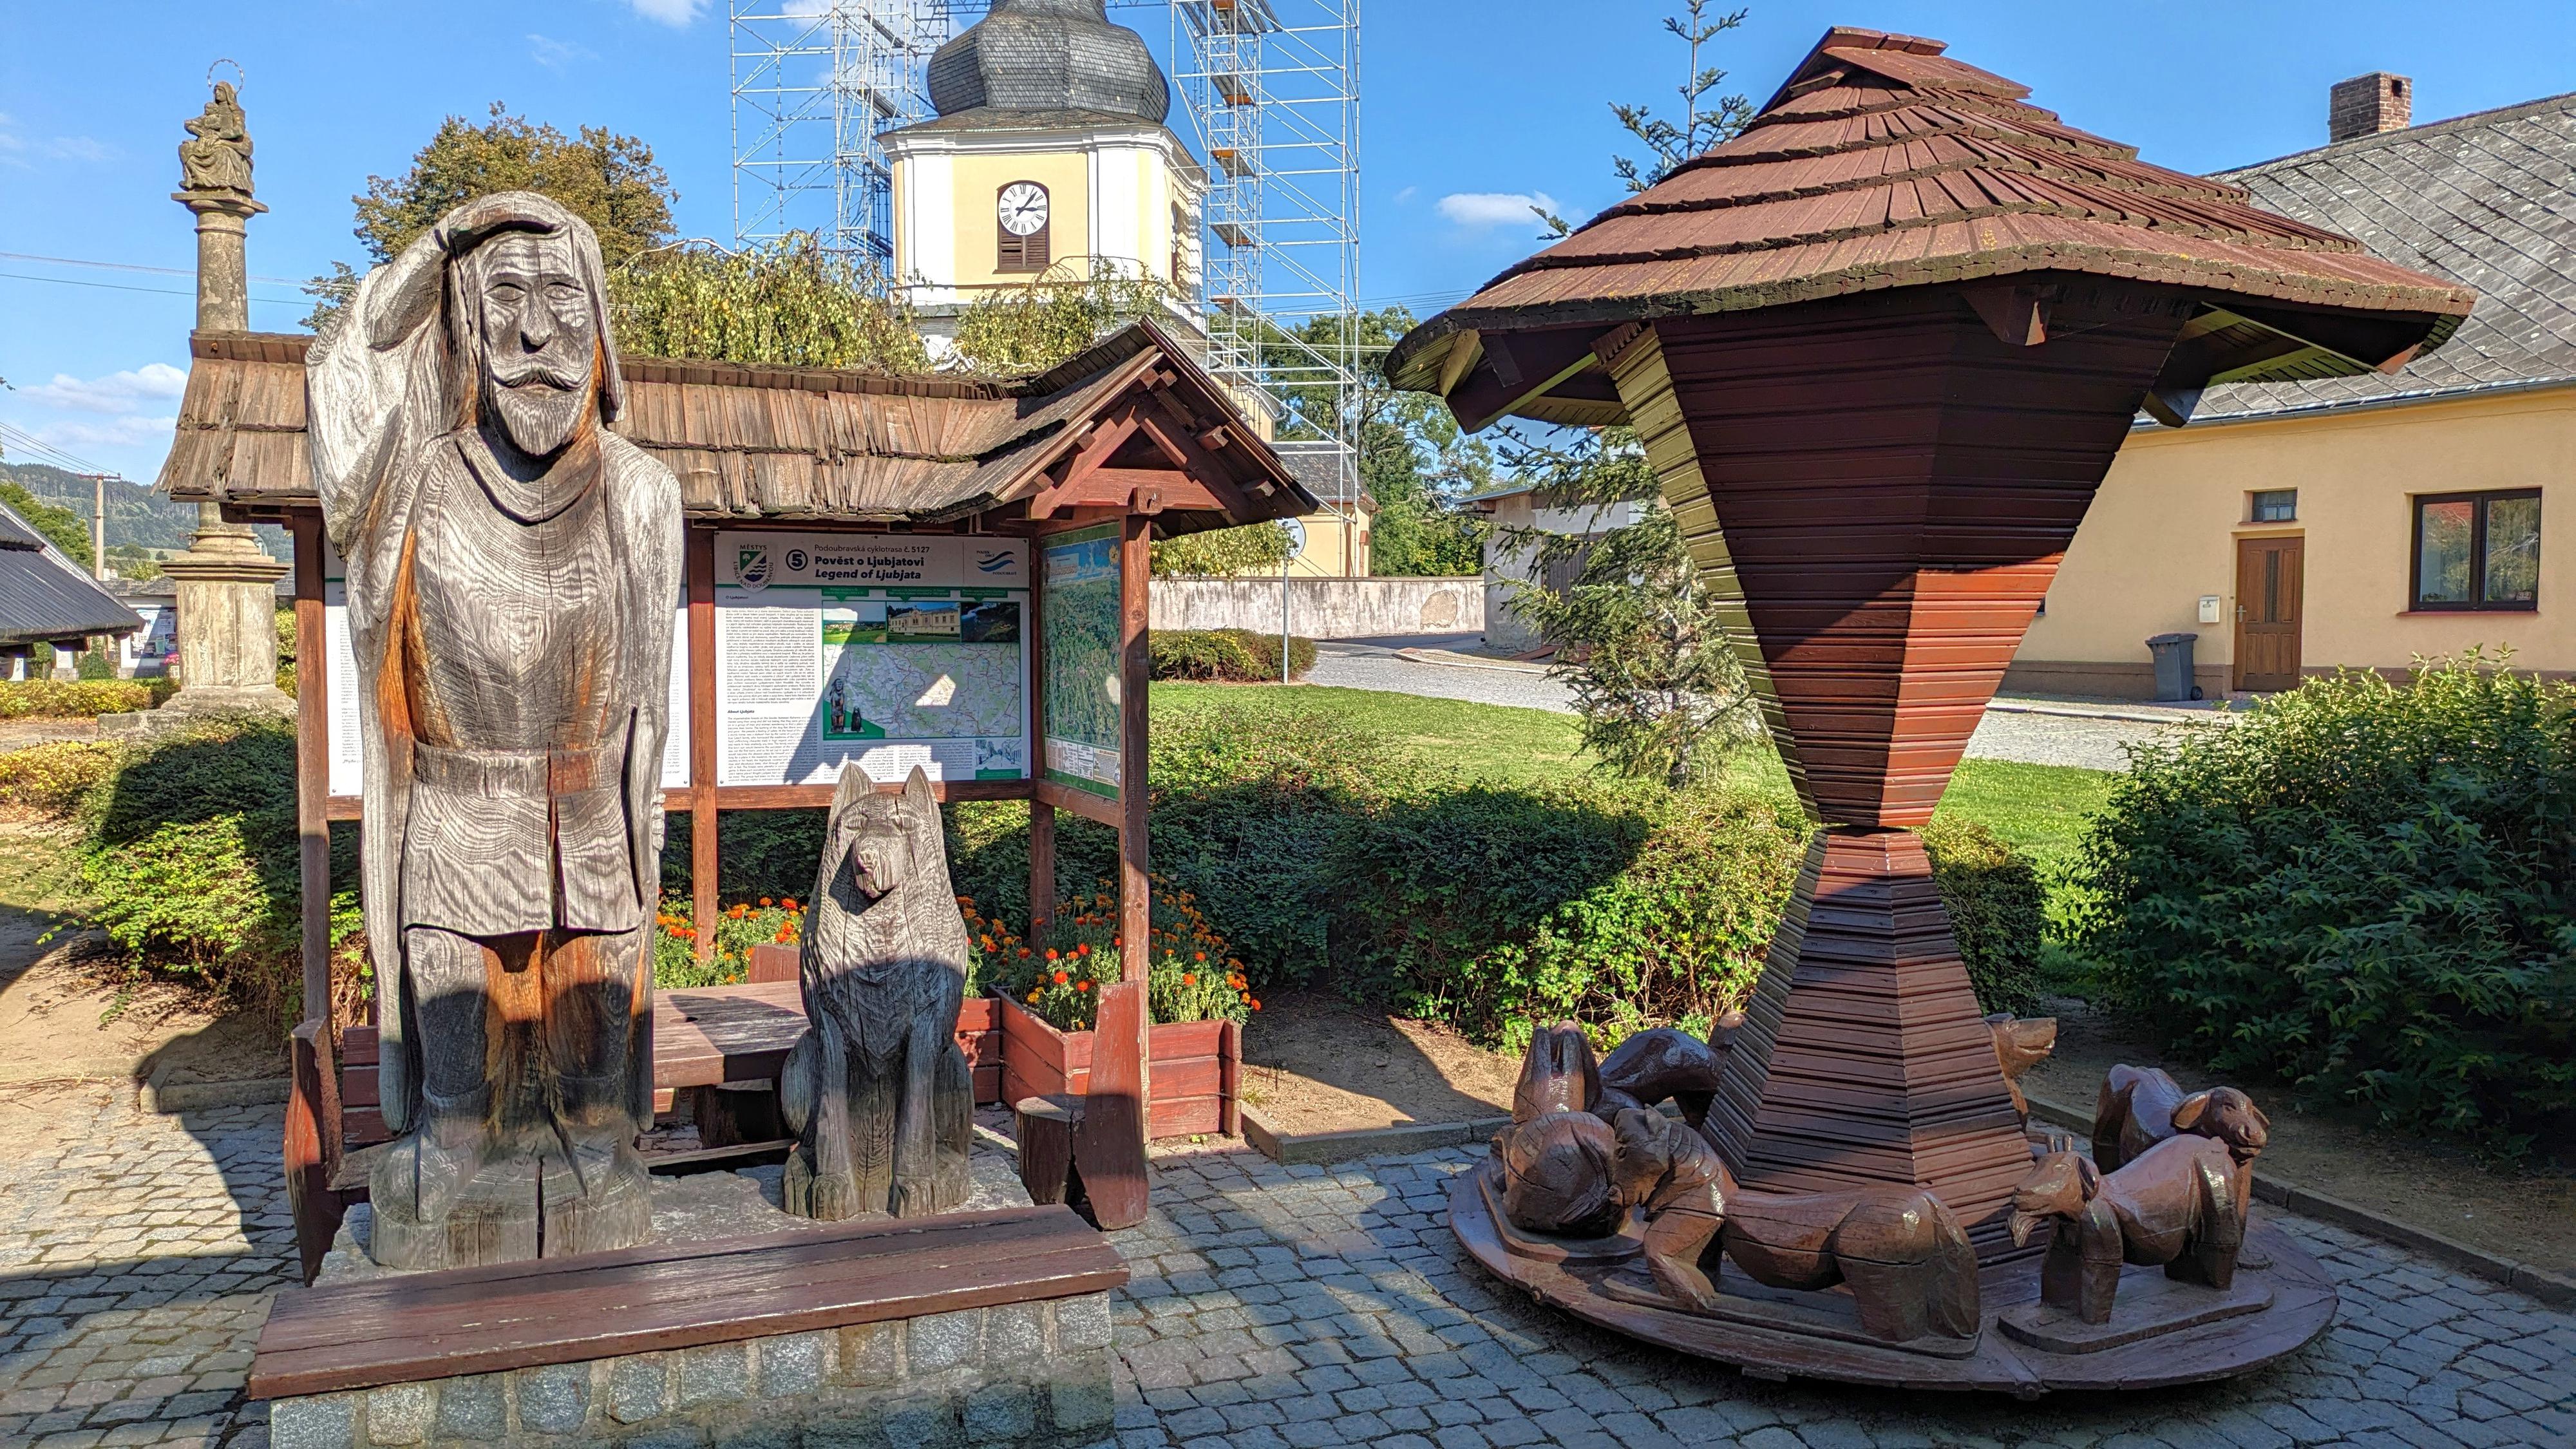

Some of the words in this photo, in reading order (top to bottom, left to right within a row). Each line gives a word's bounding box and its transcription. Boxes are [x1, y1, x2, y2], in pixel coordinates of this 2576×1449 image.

[867, 545, 902, 554] cyklotrasa
[791, 554, 803, 567] 5
[815, 556, 854, 565] Pověst
[867, 556, 924, 568] Ljubjatovi
[815, 569, 858, 580] Legend
[860, 570, 873, 579] of
[875, 570, 921, 581] Ljubjata
